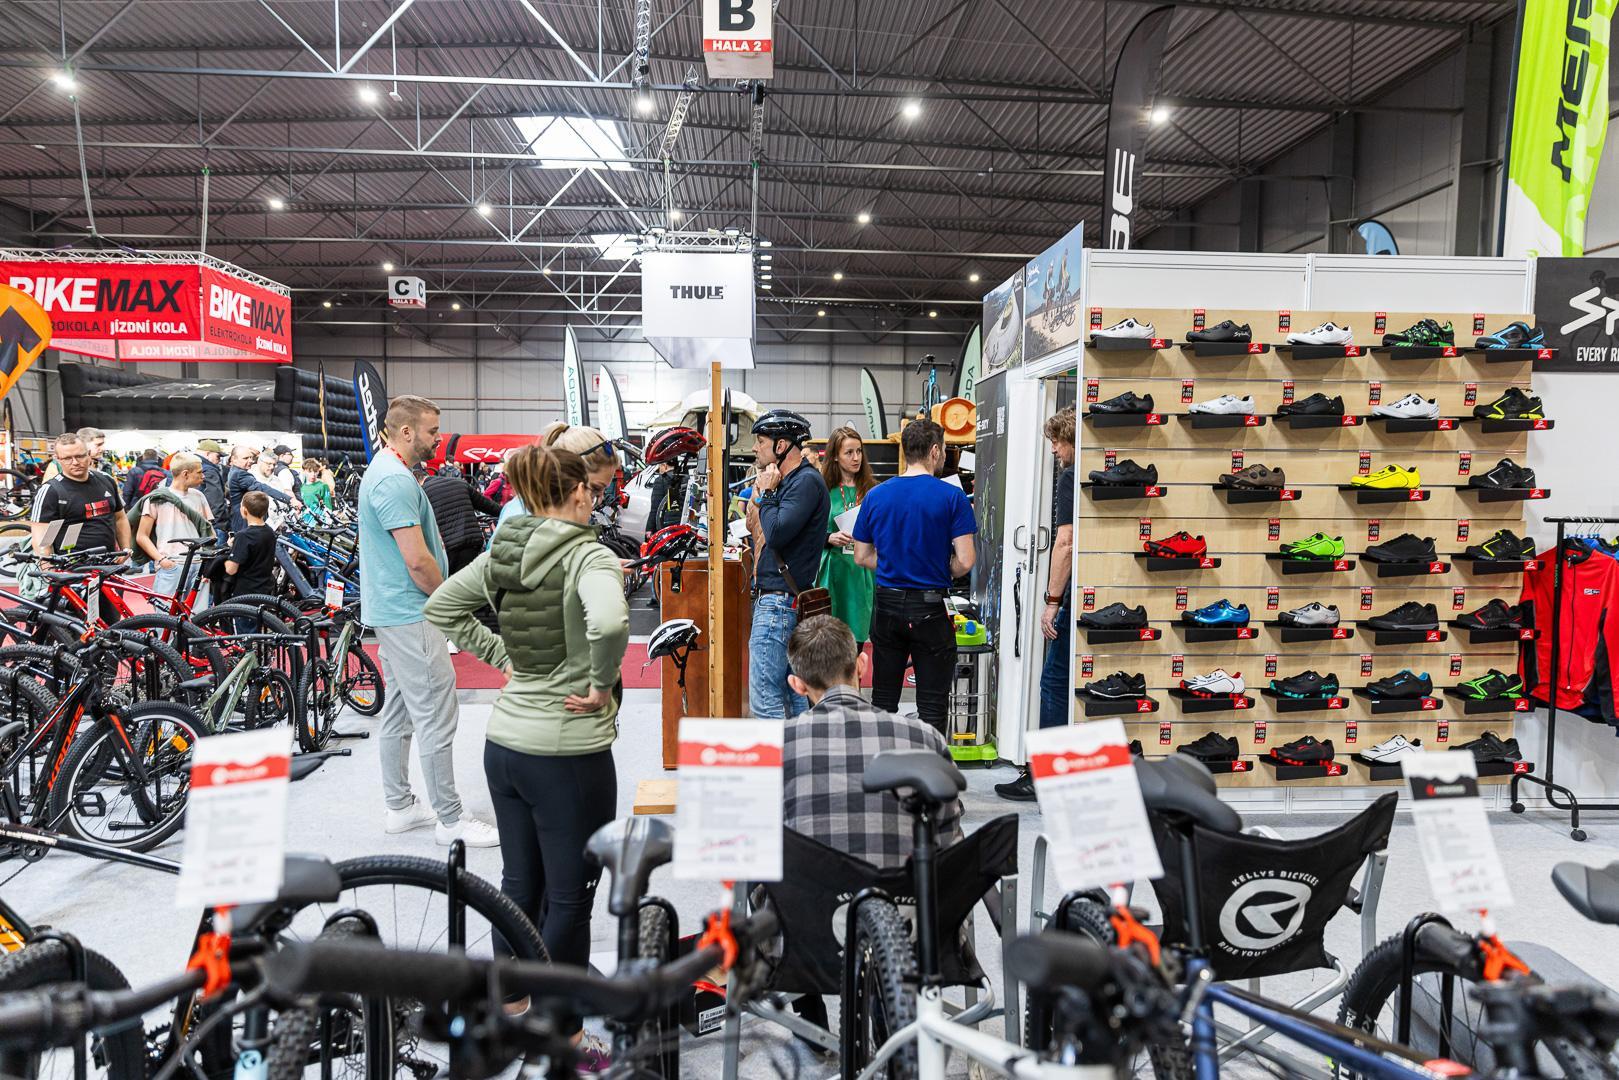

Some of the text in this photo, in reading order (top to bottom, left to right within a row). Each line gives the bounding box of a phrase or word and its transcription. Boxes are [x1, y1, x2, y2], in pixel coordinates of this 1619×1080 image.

[719, 0, 756, 32] B
[713, 40, 762, 51] HALA 2
[394, 279, 410, 296] C
[418, 282, 424, 298] C
[670, 285, 724, 300] THULE
[209, 283, 285, 336] BIKEMAX
[110, 318, 150, 335] JÍZDNÍ
[152, 321, 188, 334] KOLA
[1576, 346, 1608, 362] EVERY
[1231, 870, 1320, 887] KELLYS BICYCLES
[1217, 941, 1238, 956] RIDE
